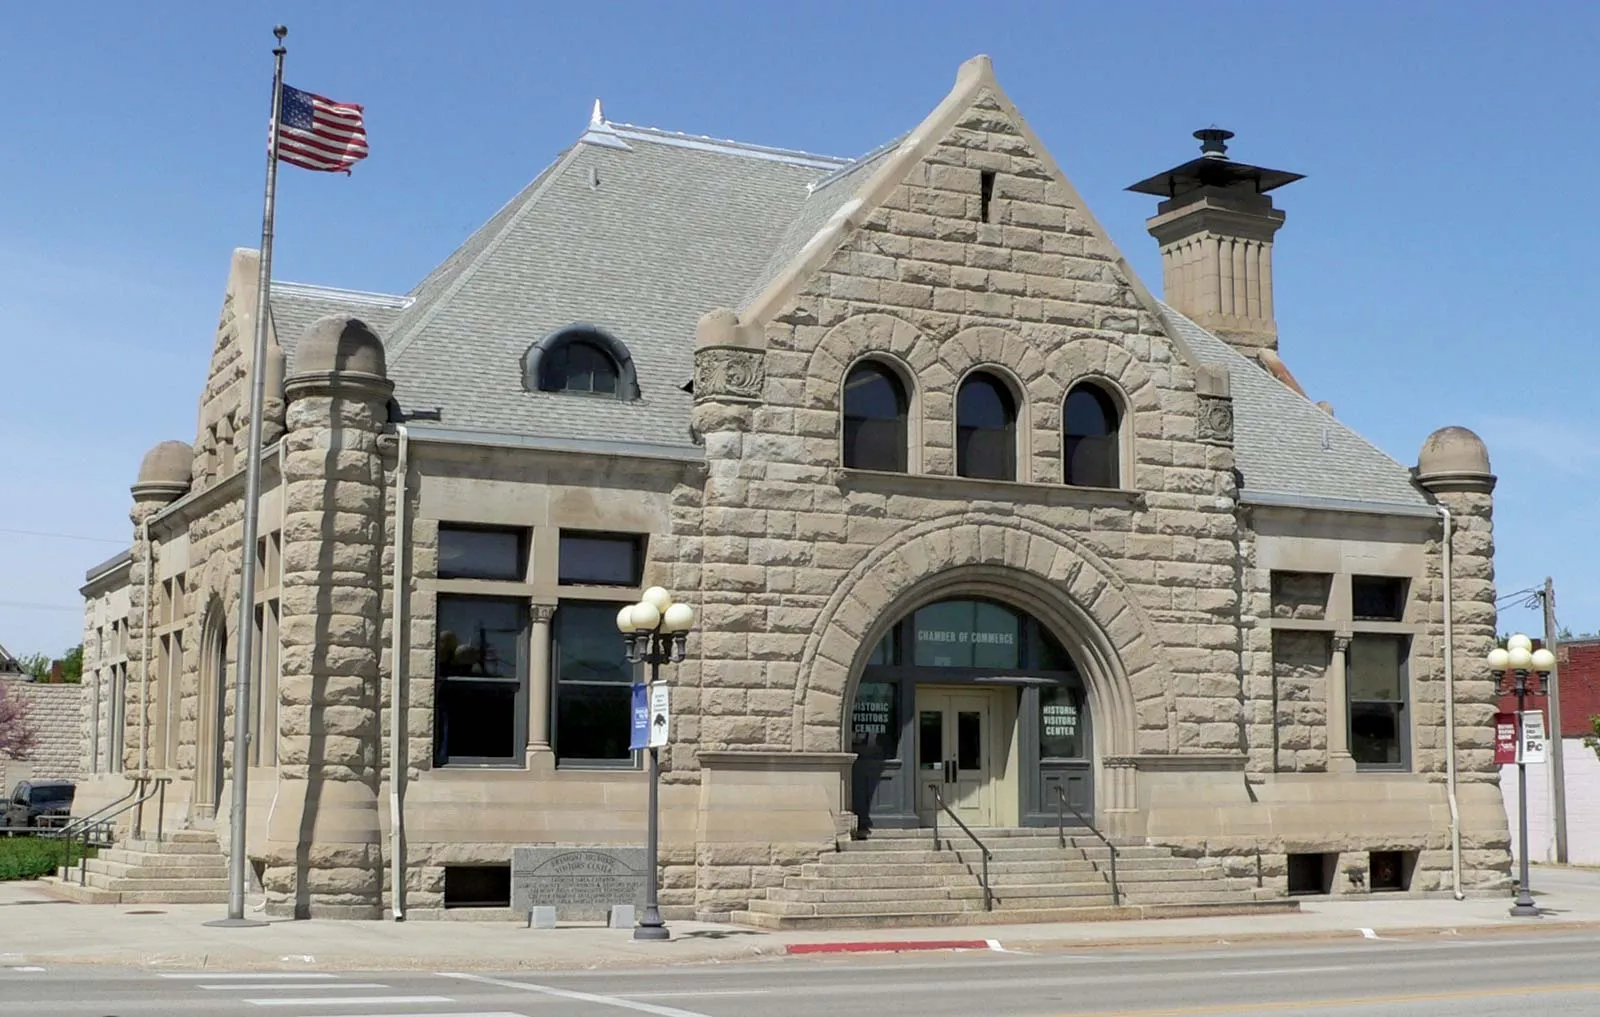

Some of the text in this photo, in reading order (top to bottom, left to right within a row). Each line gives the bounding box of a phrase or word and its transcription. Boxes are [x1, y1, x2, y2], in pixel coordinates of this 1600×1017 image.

[917, 630, 1014, 645] CHAMBER OF COMMERCE
[1043, 705, 1077, 715] HISTORIC
[853, 713, 889, 723] VISITORS
[1043, 715, 1077, 726] VISITORS
[855, 723, 887, 735] CENTER
[1045, 726, 1075, 736] CENTER
